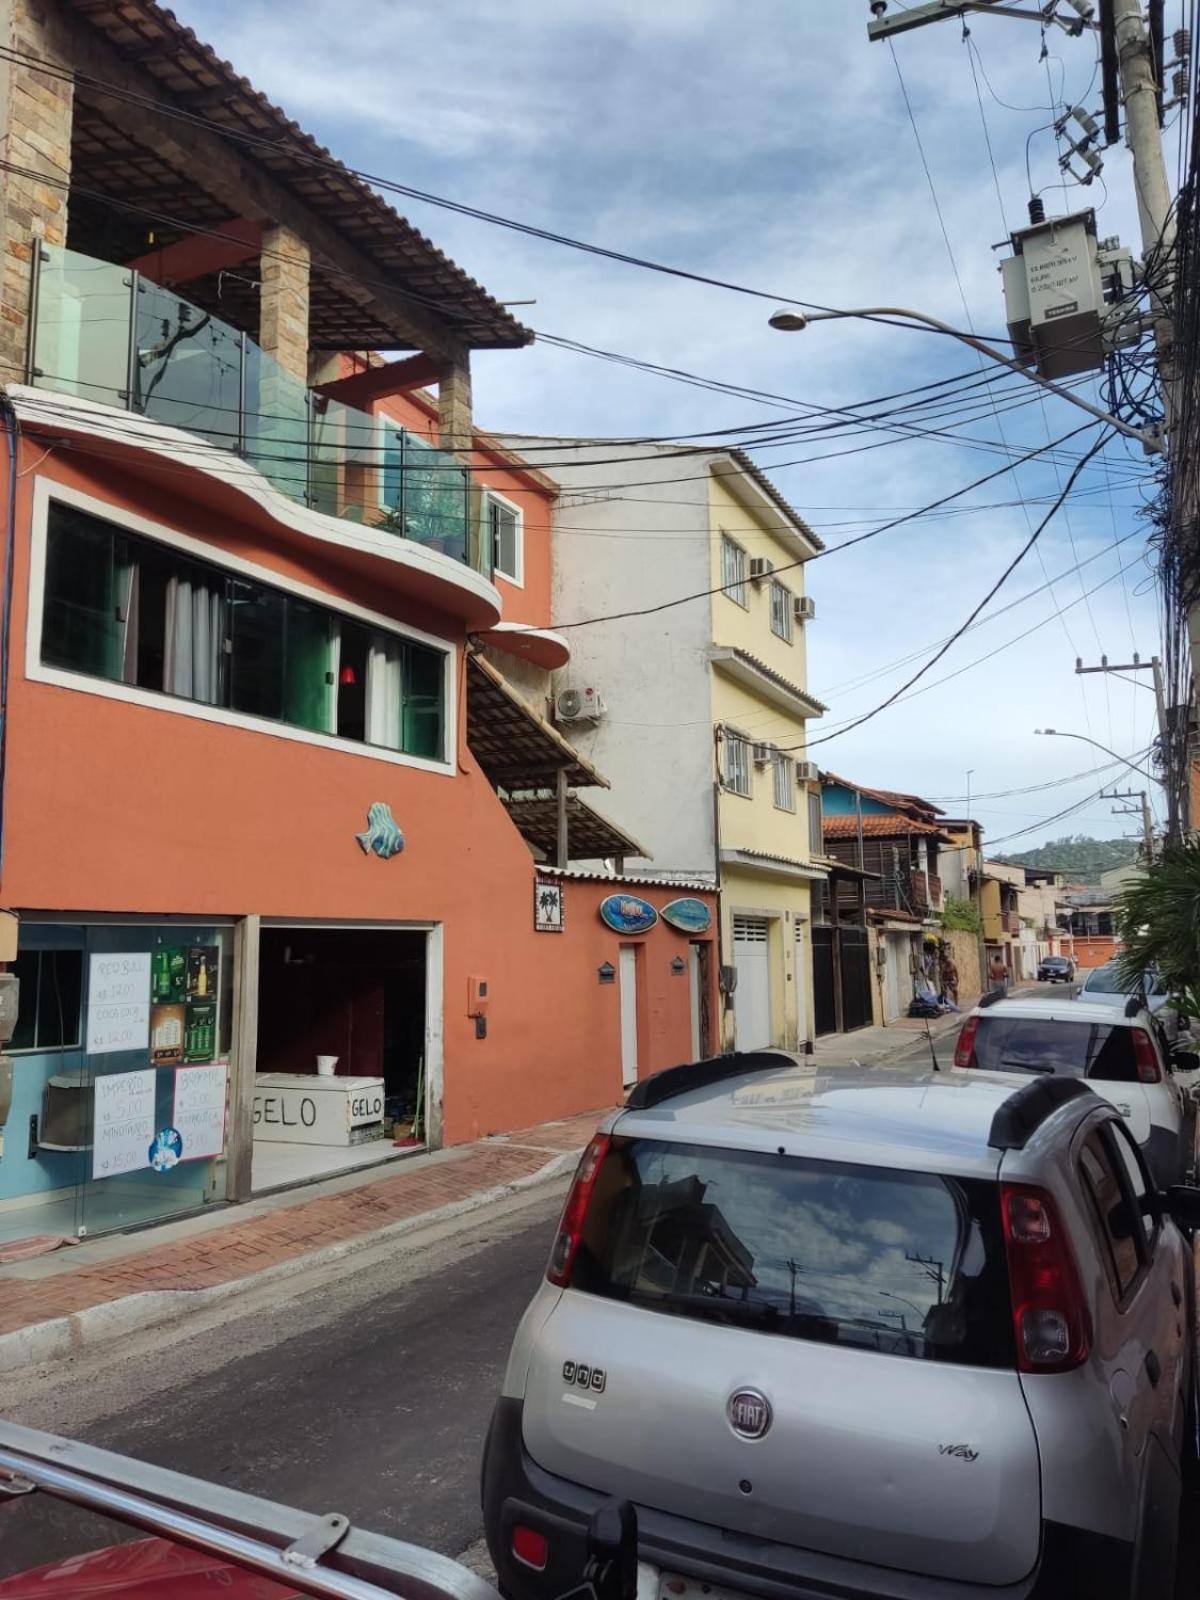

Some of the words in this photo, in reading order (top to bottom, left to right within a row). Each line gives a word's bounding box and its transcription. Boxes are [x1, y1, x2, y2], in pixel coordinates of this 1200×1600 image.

[252, 1096, 317, 1127] GELO
[351, 1097, 382, 1117] GELO
[738, 1403, 761, 1425] FIAT
